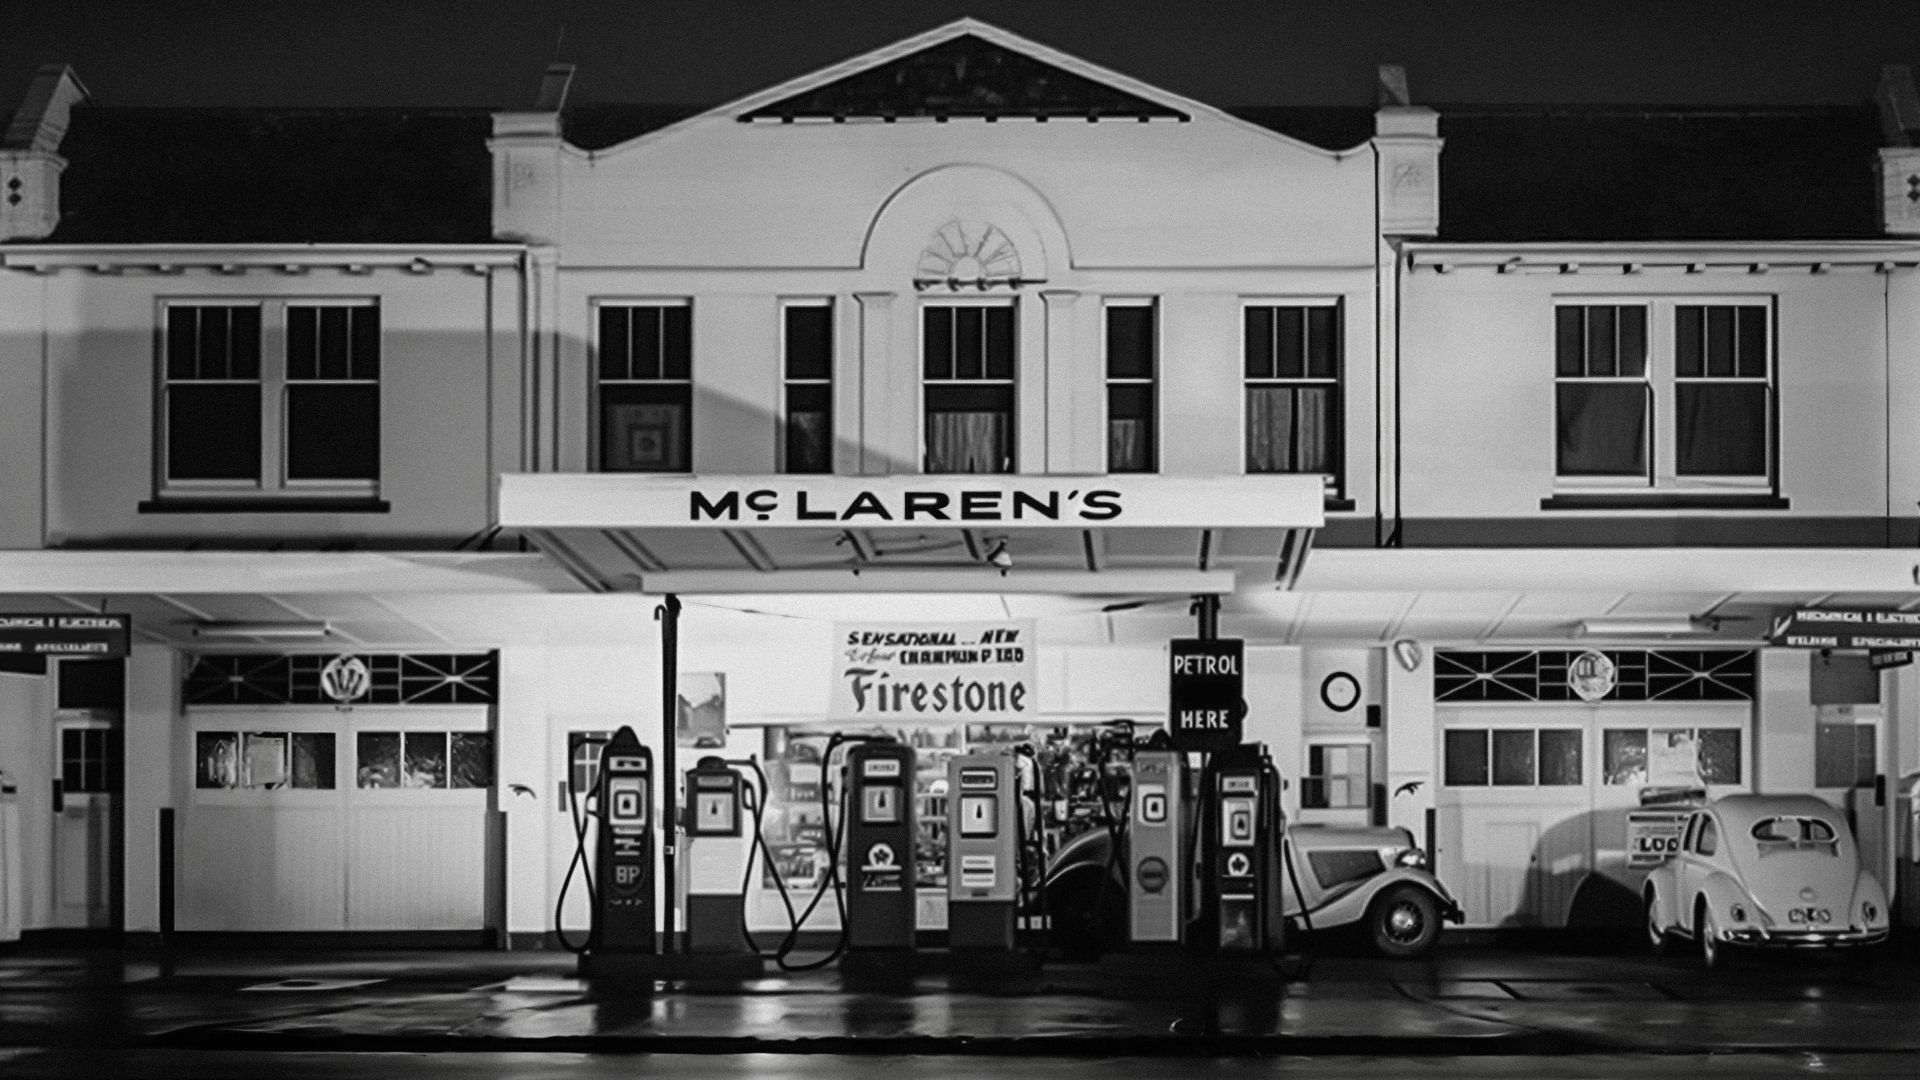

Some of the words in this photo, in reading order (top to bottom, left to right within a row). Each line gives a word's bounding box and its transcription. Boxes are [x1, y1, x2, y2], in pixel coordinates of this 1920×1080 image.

[979, 629, 1020, 645] NEW
[1174, 654, 1240, 675] PETROL
[843, 667, 1026, 712] Firestone
[1181, 709, 1230, 729] HERE
[616, 864, 641, 884] BP
